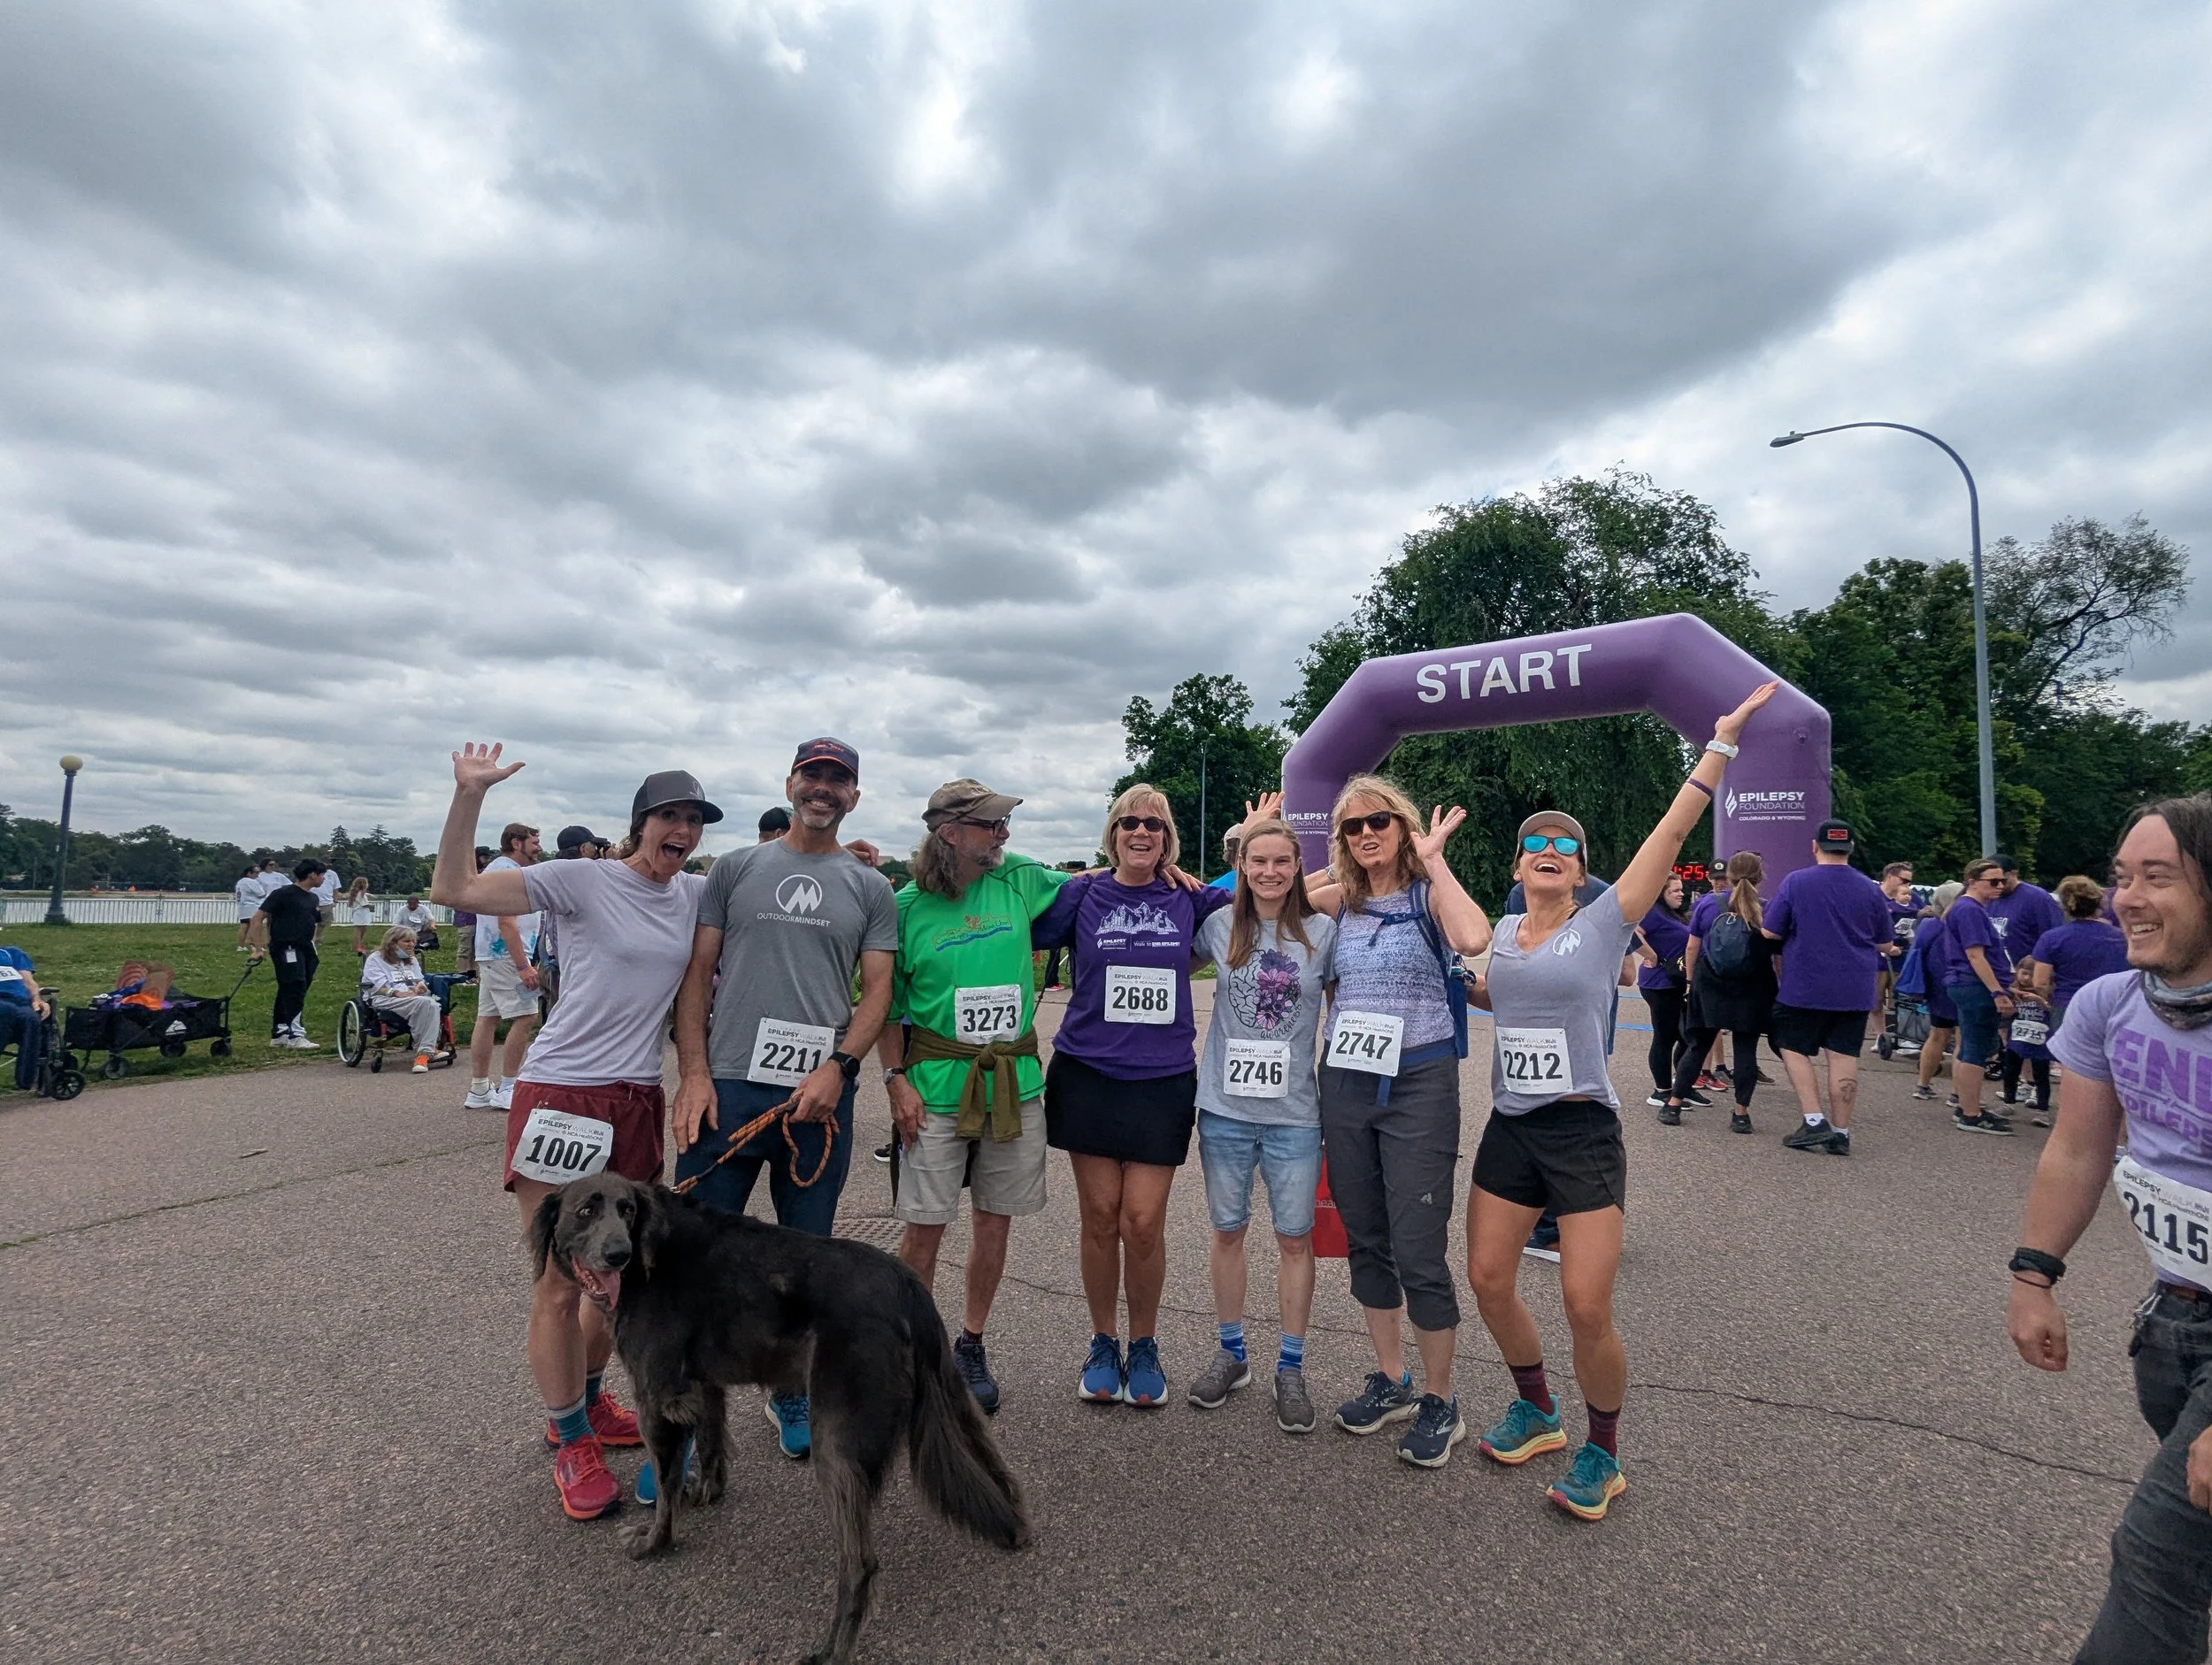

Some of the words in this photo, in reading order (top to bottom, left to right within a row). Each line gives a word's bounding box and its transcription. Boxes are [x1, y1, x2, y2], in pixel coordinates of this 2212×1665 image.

[1417, 643, 1592, 703] START
[1739, 792, 1805, 802] EPILEPSY
[1739, 802, 1805, 810] FOUNDATION
[757, 912, 831, 927] OUTDOORMINDSET
[1112, 986, 1168, 1011] 2688
[963, 1005, 1016, 1032] 3273
[1260, 1003, 1302, 1040] awareness
[768, 1028, 799, 1037] EPILEPSY
[1335, 1031, 1392, 1060] 2747
[759, 1042, 821, 1074] 2211
[1504, 1050, 1563, 1079] 2212
[1229, 1059, 1282, 1085] 2746
[538, 1118, 572, 1131] EPILEPSY
[526, 1134, 602, 1172] 1007
[2124, 1170, 2161, 1193] EPILEPSY
[2124, 1191, 2208, 1265] 2115
